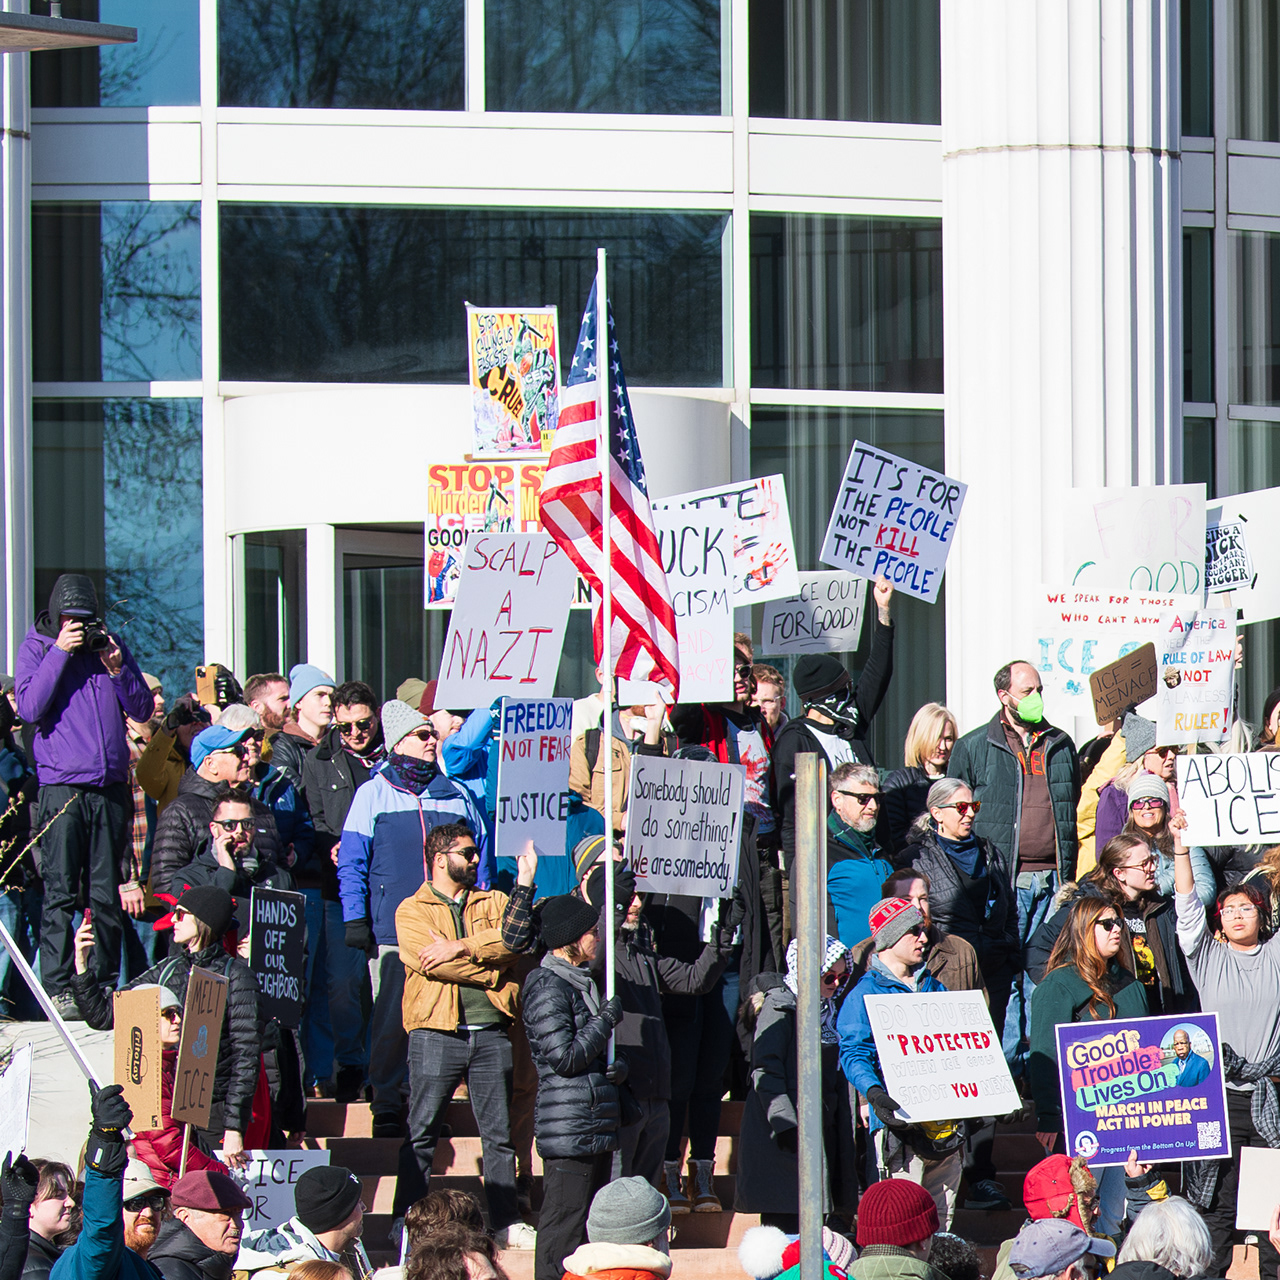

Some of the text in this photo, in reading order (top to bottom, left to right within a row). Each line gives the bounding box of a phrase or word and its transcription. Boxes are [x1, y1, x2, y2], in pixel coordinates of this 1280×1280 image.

[429, 465, 514, 491] STOP
[847, 448, 909, 491] IT'S
[843, 487, 882, 517] THE
[836, 514, 870, 537] NOT
[1232, 526, 1241, 534] A
[834, 534, 872, 567] THE
[1229, 558, 1246, 569] ANY
[827, 578, 862, 602] OUT
[1047, 593, 1066, 603] WE
[1074, 593, 1100, 603] SPEAK
[1109, 596, 1130, 604] FOR
[498, 589, 513, 627] A
[1061, 612, 1089, 622] WHO
[771, 605, 860, 644] FOR GOOD!
[1169, 615, 1227, 633] America
[446, 626, 553, 684] NAZI
[1038, 638, 1098, 675] ICE
[1162, 650, 1232, 665] RULE OF LAW
[1095, 665, 1157, 712] MENACE
[1096, 665, 1125, 692] ICE
[1184, 669, 1212, 683] NOT
[1175, 690, 1227, 703] LAWLESS
[504, 701, 574, 734] FREEDOM
[502, 735, 571, 762] NOT FEAR
[635, 768, 731, 815] Somebody should
[499, 791, 570, 823] JUSTICE
[1214, 794, 1280, 837] ICE
[641, 805, 737, 851] do something!
[631, 845, 731, 891] We are somebody.
[256, 900, 297, 927] HANDS
[264, 929, 287, 950] OFF
[265, 953, 288, 973] OUR
[192, 980, 225, 1018] MELT
[256, 972, 299, 1002] EIGHBORS
[875, 1003, 990, 1030] DO YOU FEEL
[887, 1030, 993, 1056] "PROTECTED"
[1072, 1033, 1129, 1066] Good
[891, 1054, 996, 1078] WHEN ICE COULD
[1076, 1052, 1151, 1086] Trouble
[179, 1069, 209, 1111] ICE
[899, 1082, 978, 1106] SHOOT YOU
[1080, 1070, 1168, 1108] Lives On
[1095, 1098, 1208, 1118] MARCH IN PEACE
[1096, 1113, 1192, 1131] ACT IN POWER
[1100, 1146, 1126, 1154] Progress
[1152, 1142, 1174, 1150] Bottom
[1185, 1140, 1197, 1148] Up!
[254, 1158, 304, 1188] ICE
